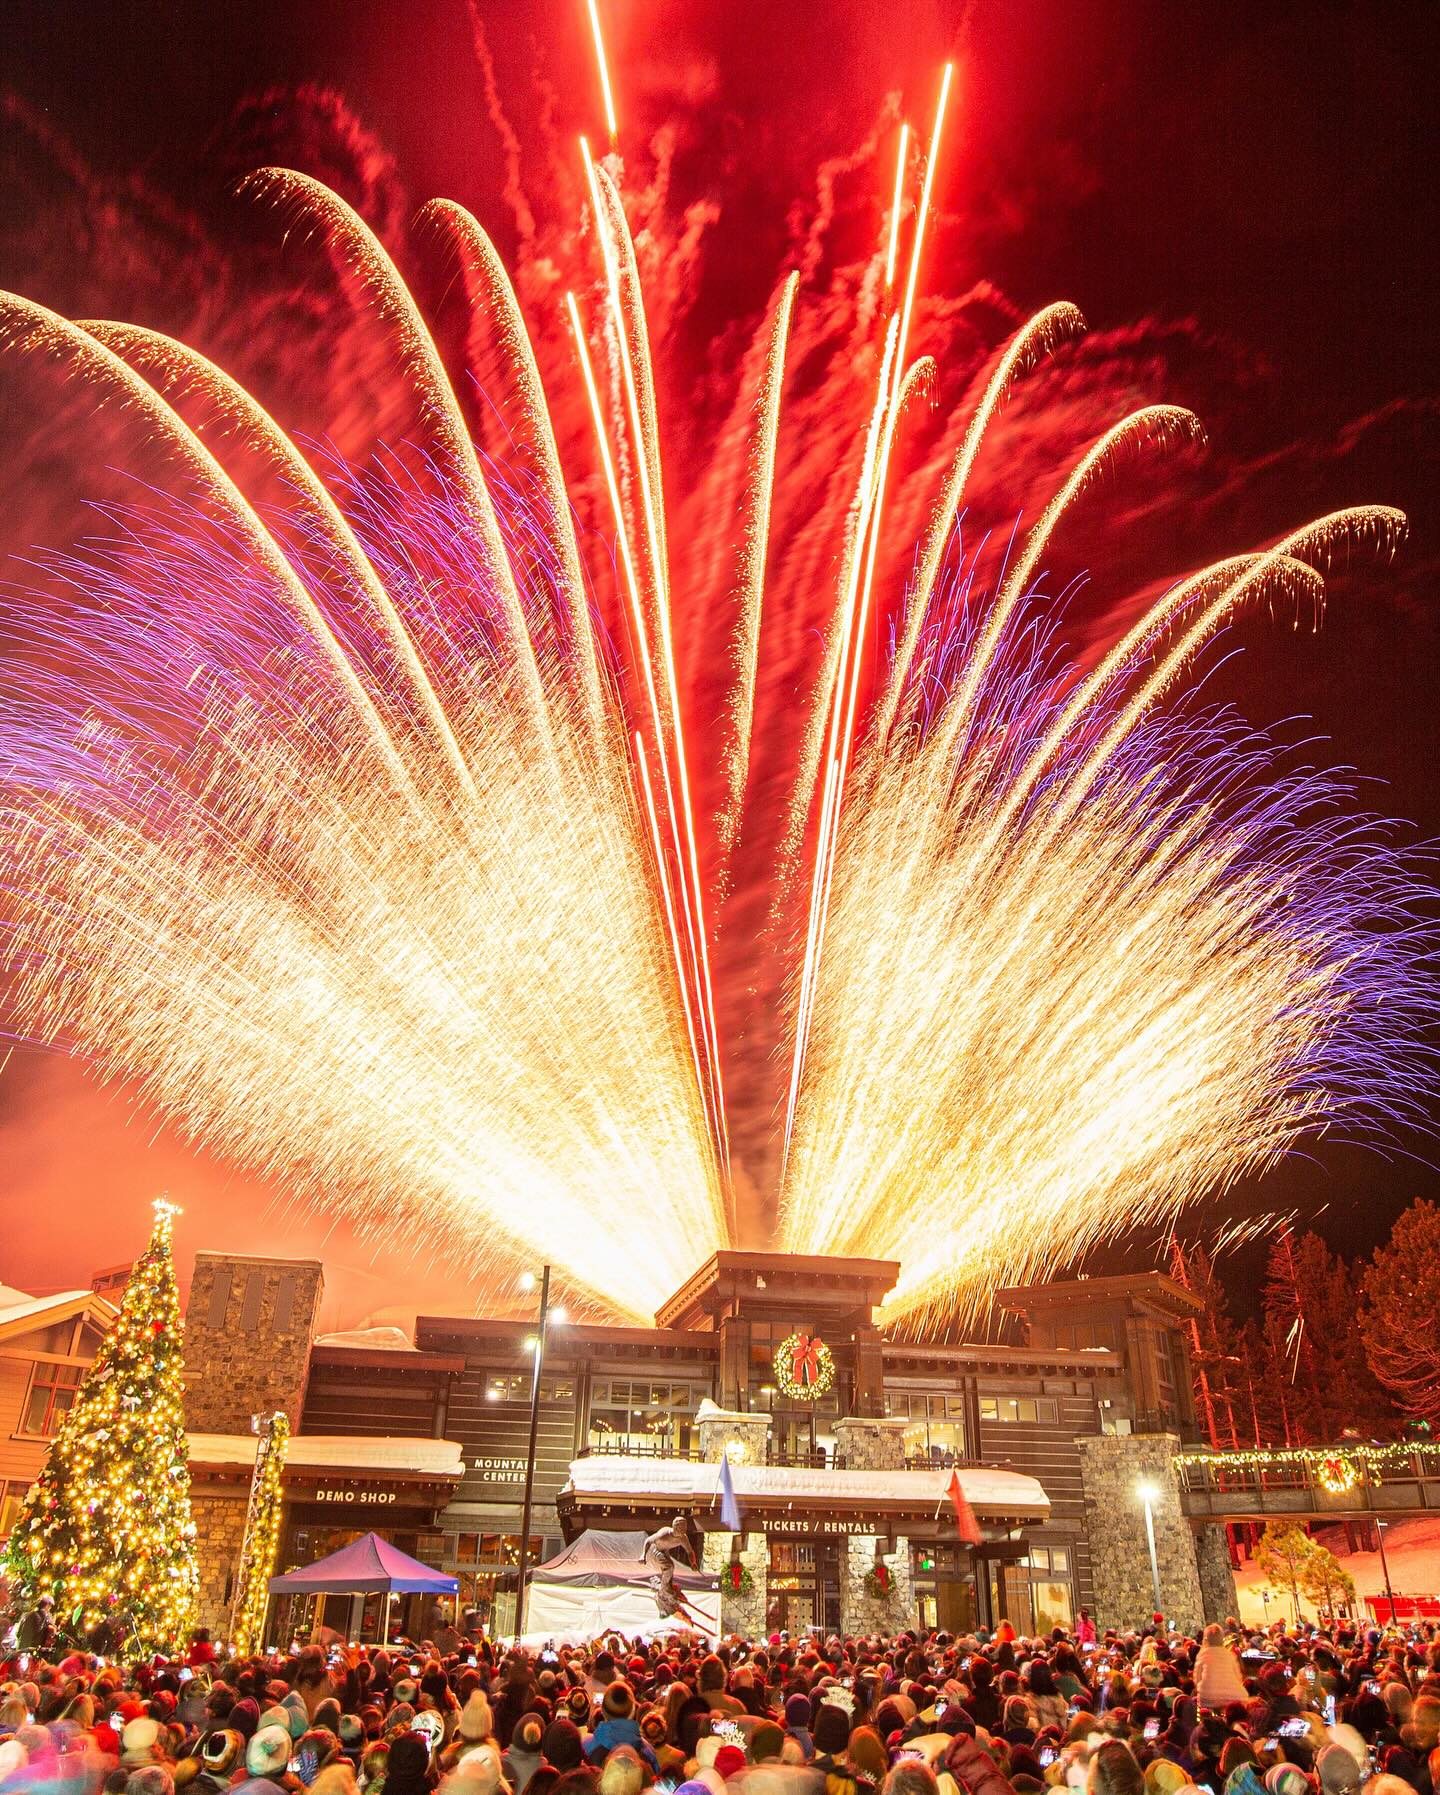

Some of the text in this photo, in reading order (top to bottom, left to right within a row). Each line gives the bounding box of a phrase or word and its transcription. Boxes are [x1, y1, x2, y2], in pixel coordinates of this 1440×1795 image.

[483, 1472, 526, 1482] CENTER
[316, 1490, 396, 1504] DEMO SHOP
[762, 1521, 809, 1532] TICKETS
[824, 1522, 876, 1533] RENTALS
